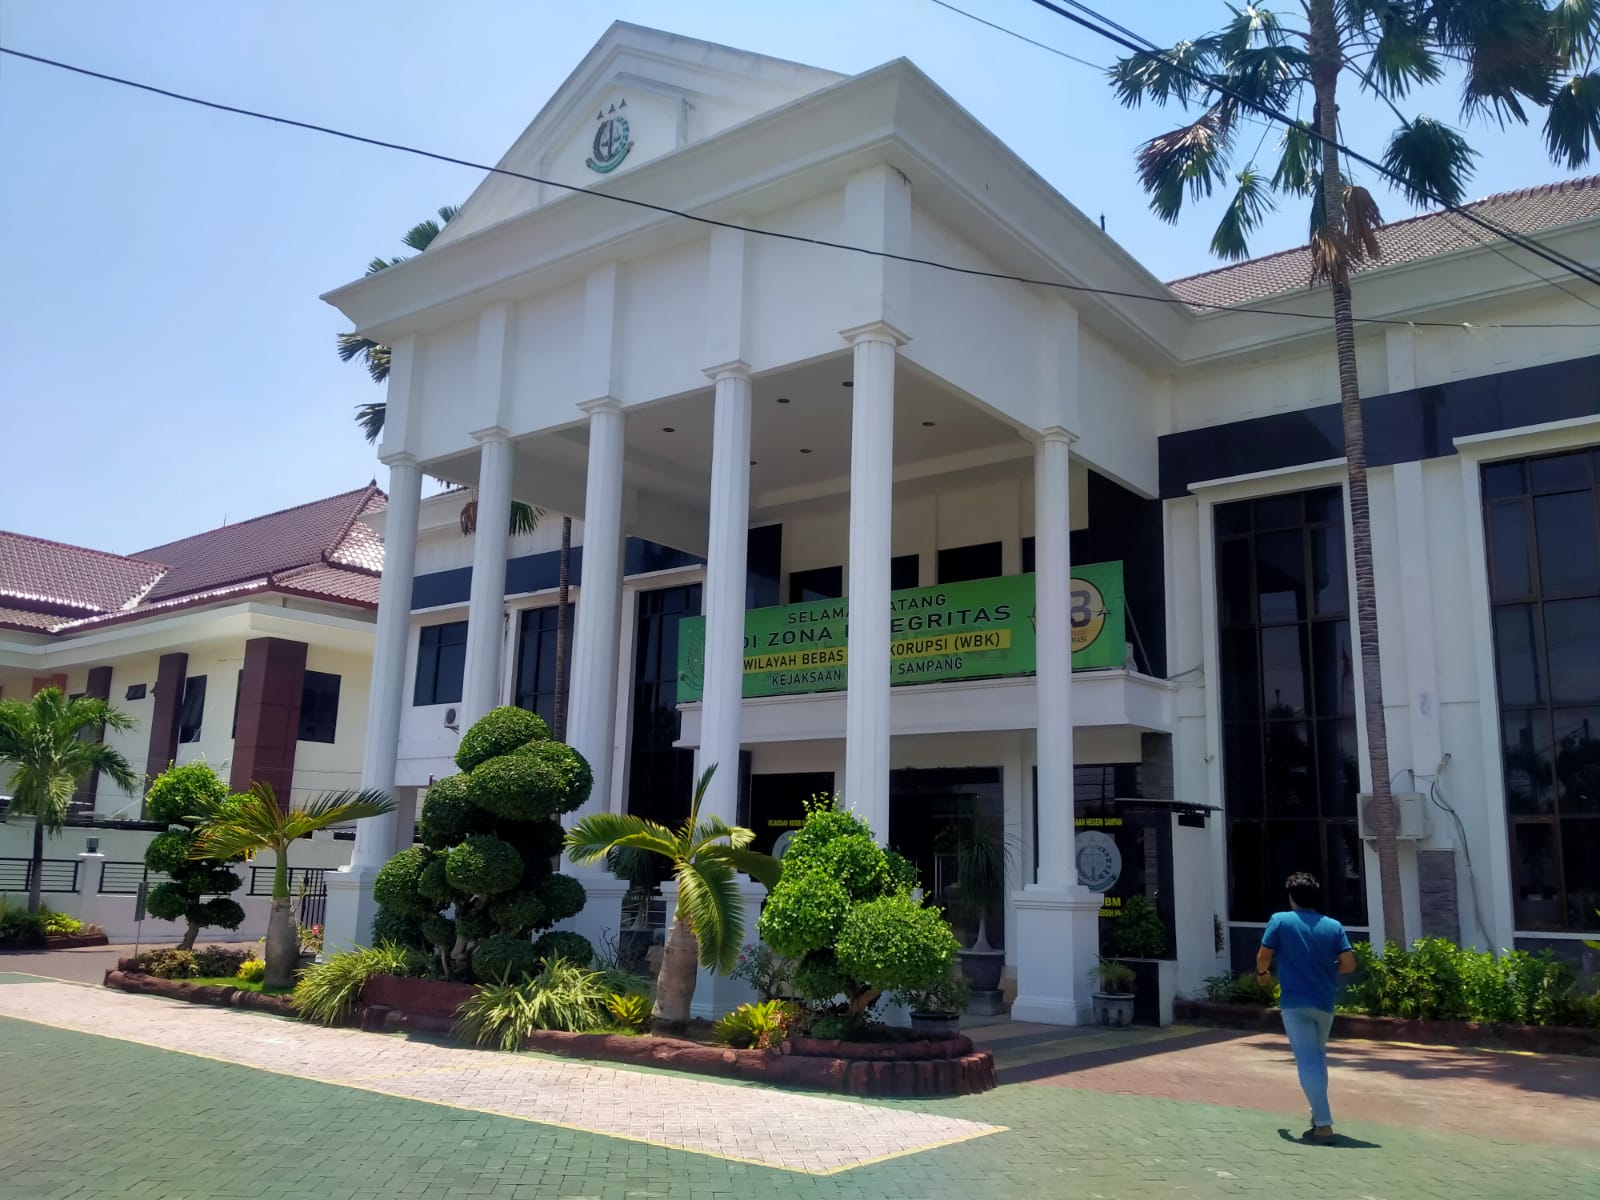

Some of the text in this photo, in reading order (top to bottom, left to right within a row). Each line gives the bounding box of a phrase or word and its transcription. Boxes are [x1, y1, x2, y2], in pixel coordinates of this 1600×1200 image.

[788, 594, 946, 624] SELAM ATANG
[768, 626, 832, 647] ZONA
[743, 633, 1001, 670] WILAYAH BEBAS KORUPSI (WBK)
[772, 670, 842, 686] KEJAKSAAN
[898, 657, 963, 675] SAMPANG
[1104, 897, 1121, 907] BM
